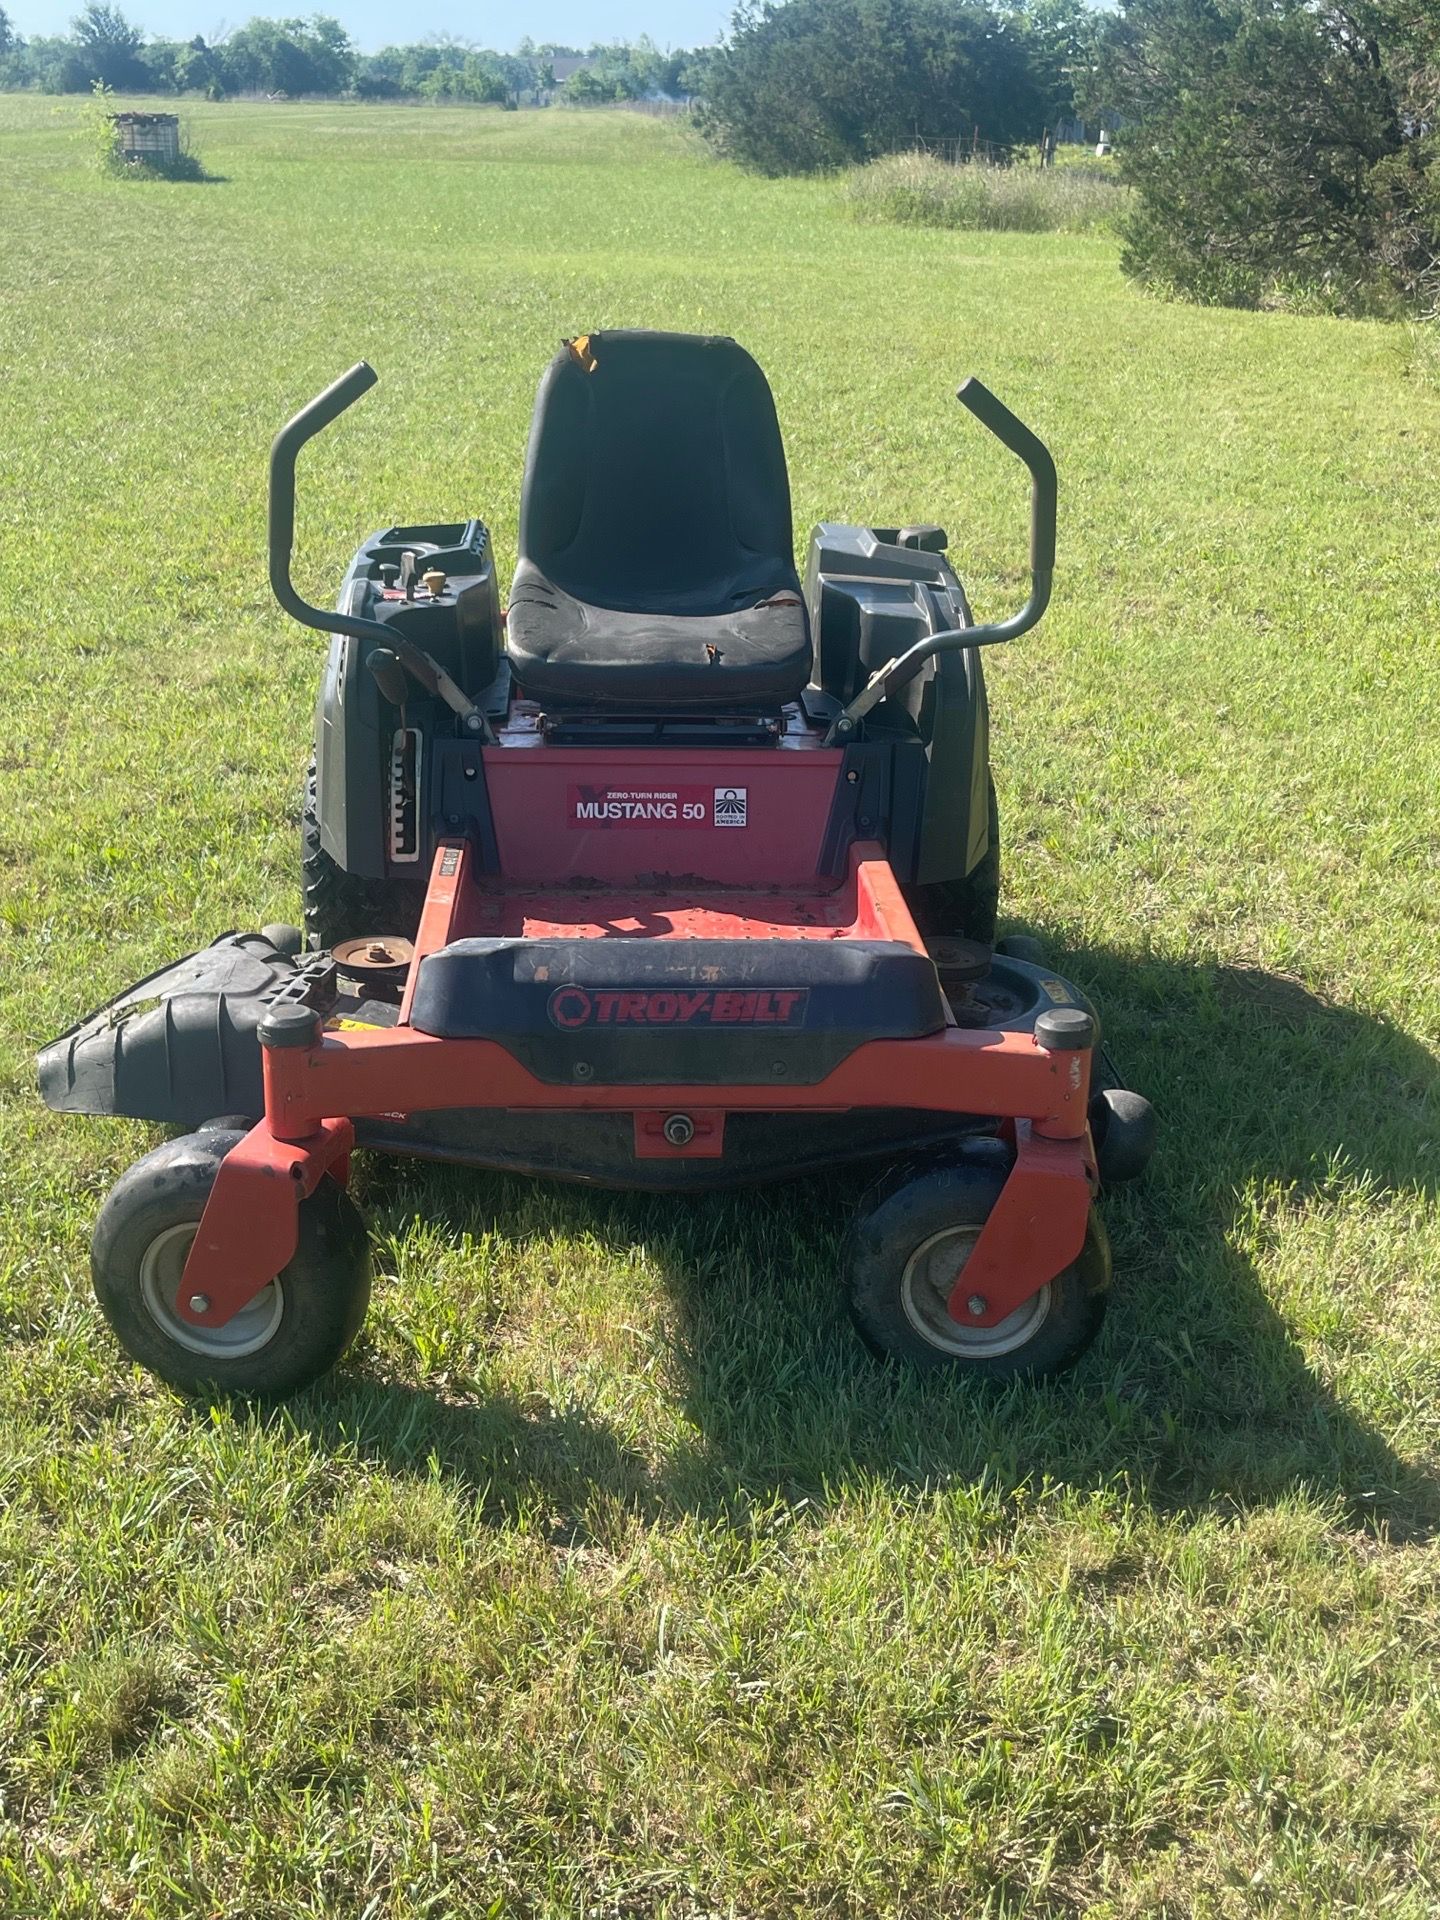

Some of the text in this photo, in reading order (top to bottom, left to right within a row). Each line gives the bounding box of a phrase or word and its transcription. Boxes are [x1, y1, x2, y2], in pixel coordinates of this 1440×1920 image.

[606, 792, 678, 800] ZERO-TURN RIDER
[576, 802, 706, 820] MUSTANG 50
[594, 991, 801, 1023] TROY-BILT
